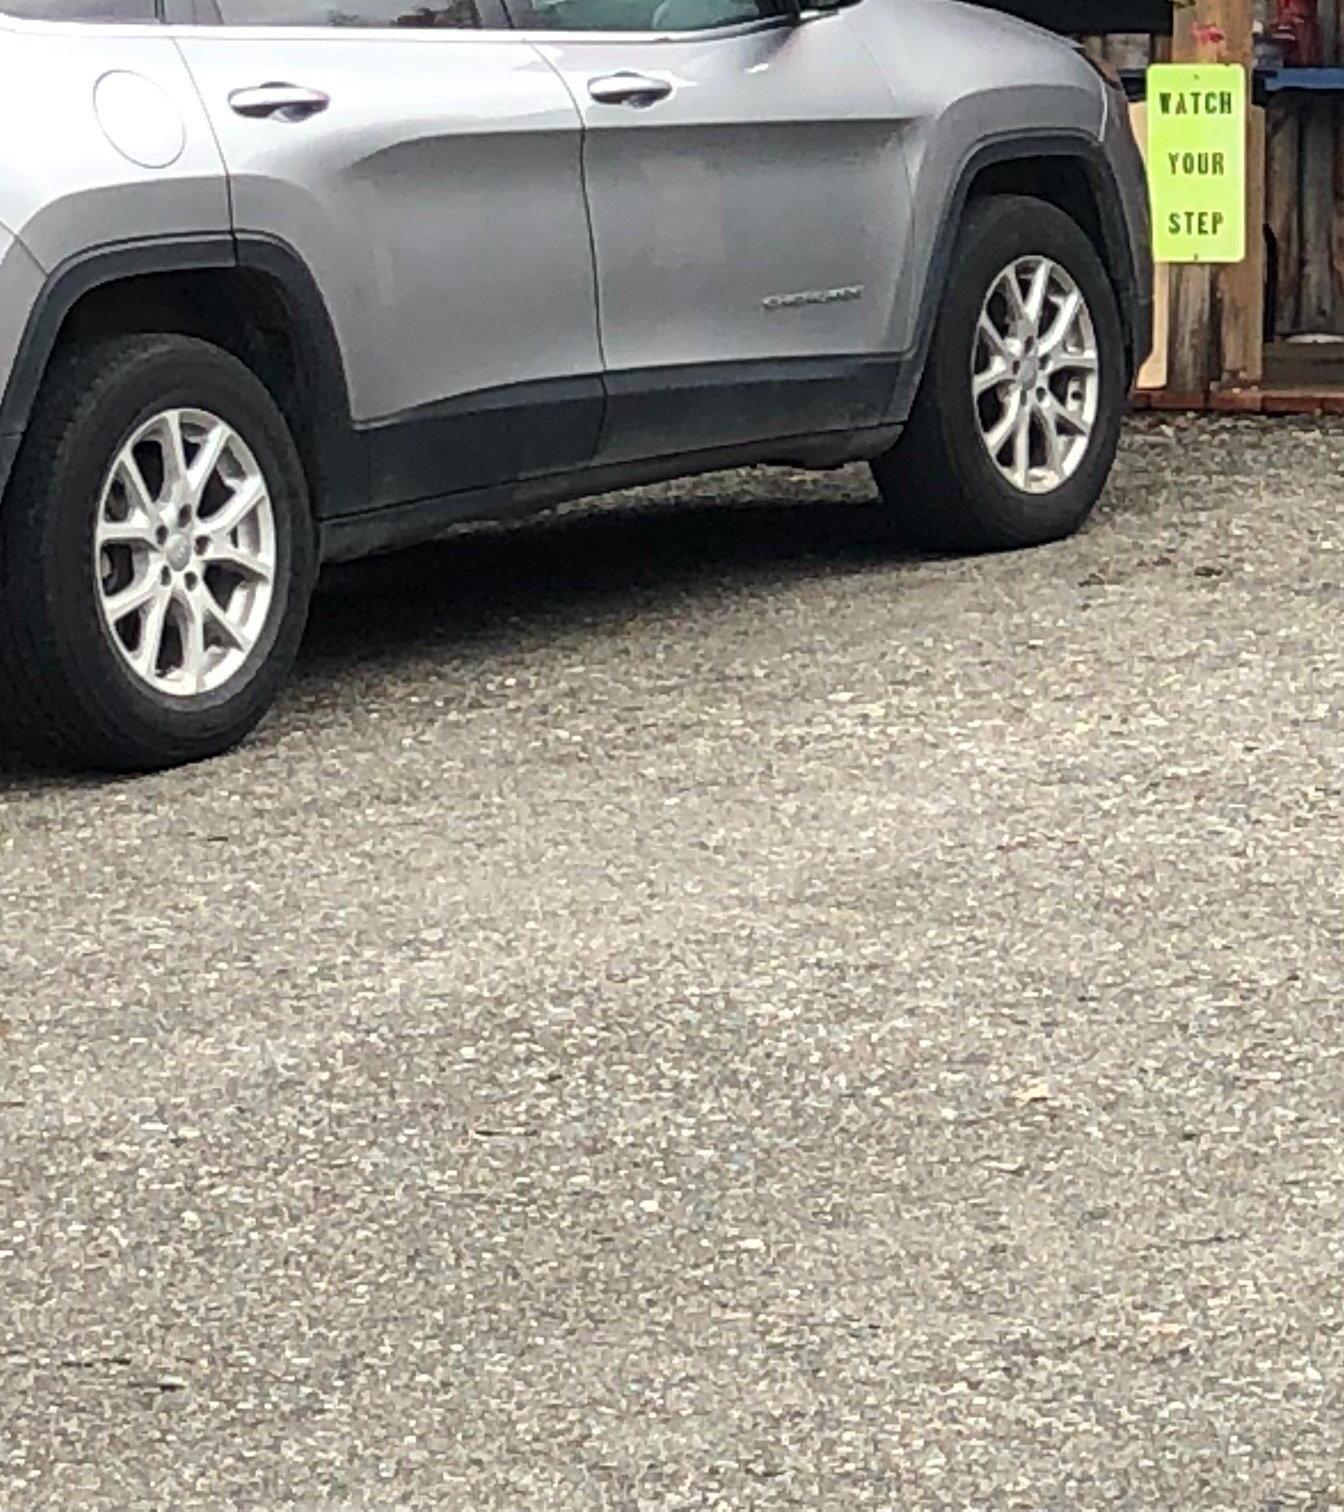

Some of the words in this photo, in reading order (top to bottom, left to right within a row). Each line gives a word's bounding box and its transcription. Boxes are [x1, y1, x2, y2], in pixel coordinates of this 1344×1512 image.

[1159, 91, 1233, 115] WATCH
[1168, 152, 1224, 176] YOUR
[1169, 211, 1224, 236] STEP
